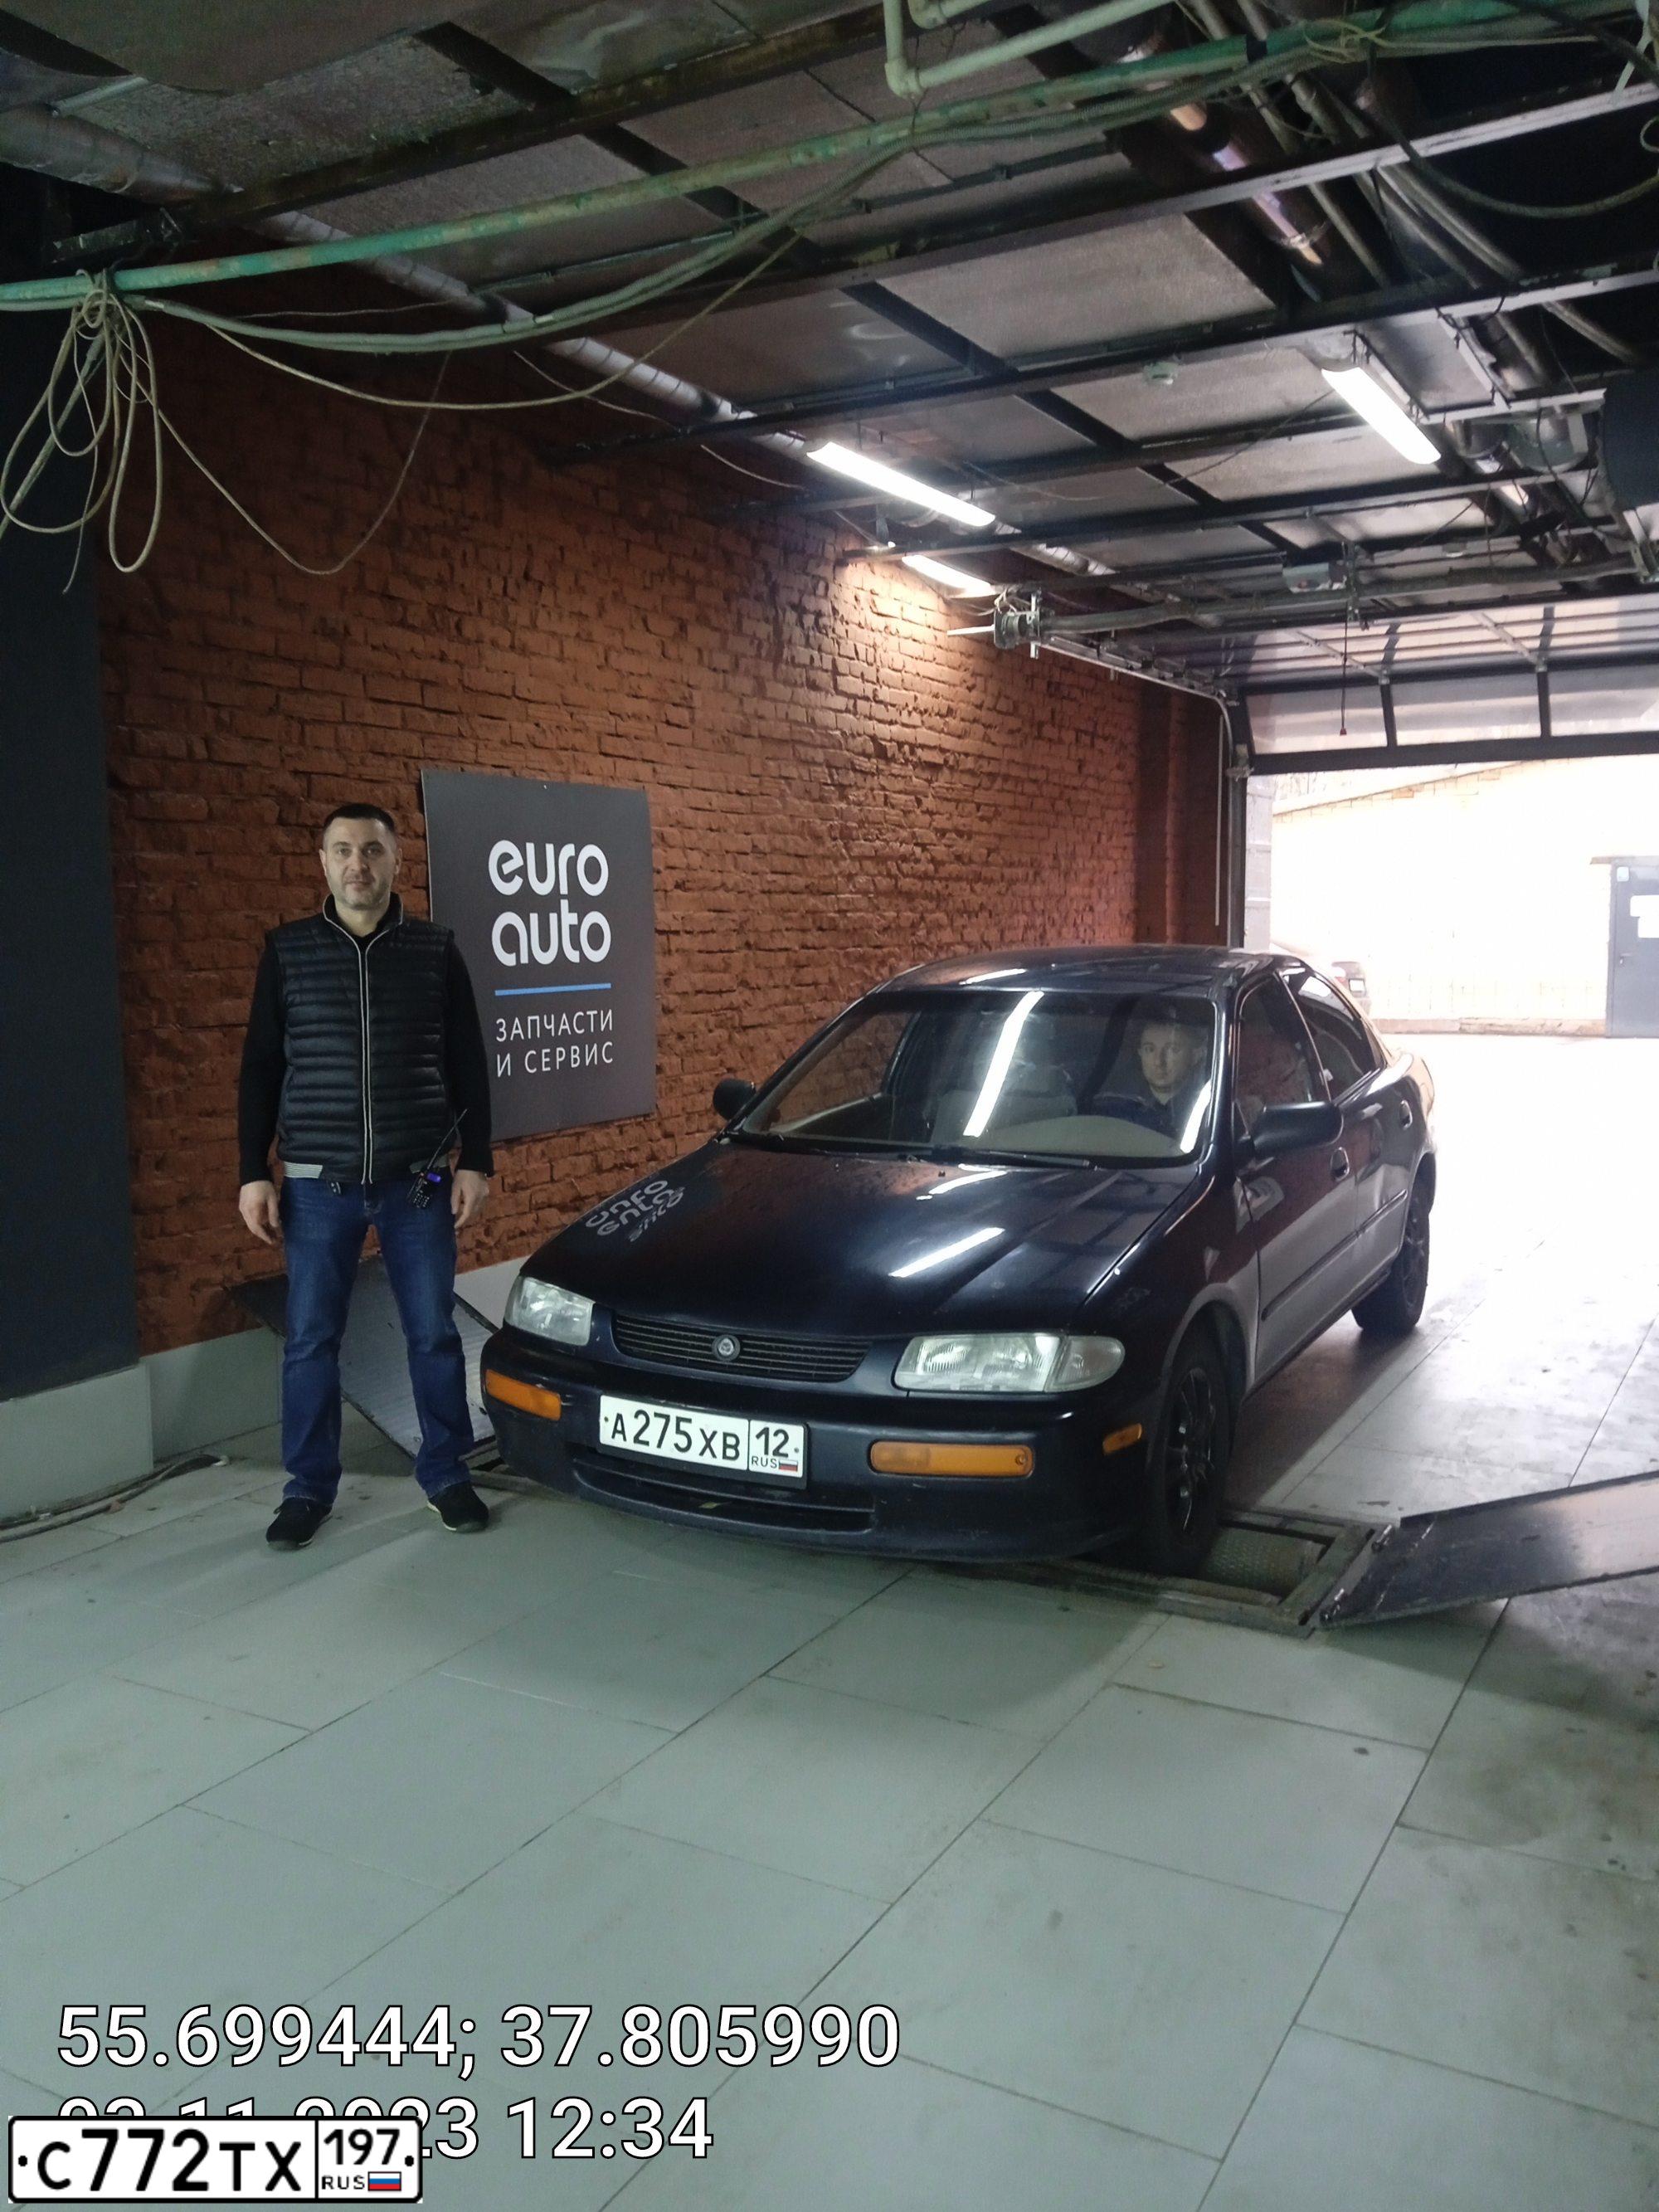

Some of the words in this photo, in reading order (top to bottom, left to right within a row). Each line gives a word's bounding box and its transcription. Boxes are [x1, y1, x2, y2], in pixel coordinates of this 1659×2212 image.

[488, 840, 609, 896] euro
[491, 899, 611, 967] auto
[496, 1008, 613, 1042] ЗАПЧАСТИ
[497, 1053, 511, 1077] И
[524, 1041, 613, 1074] СЕРВИС
[756, 1426, 790, 1459] 12
[751, 1454, 777, 1469] RUS
